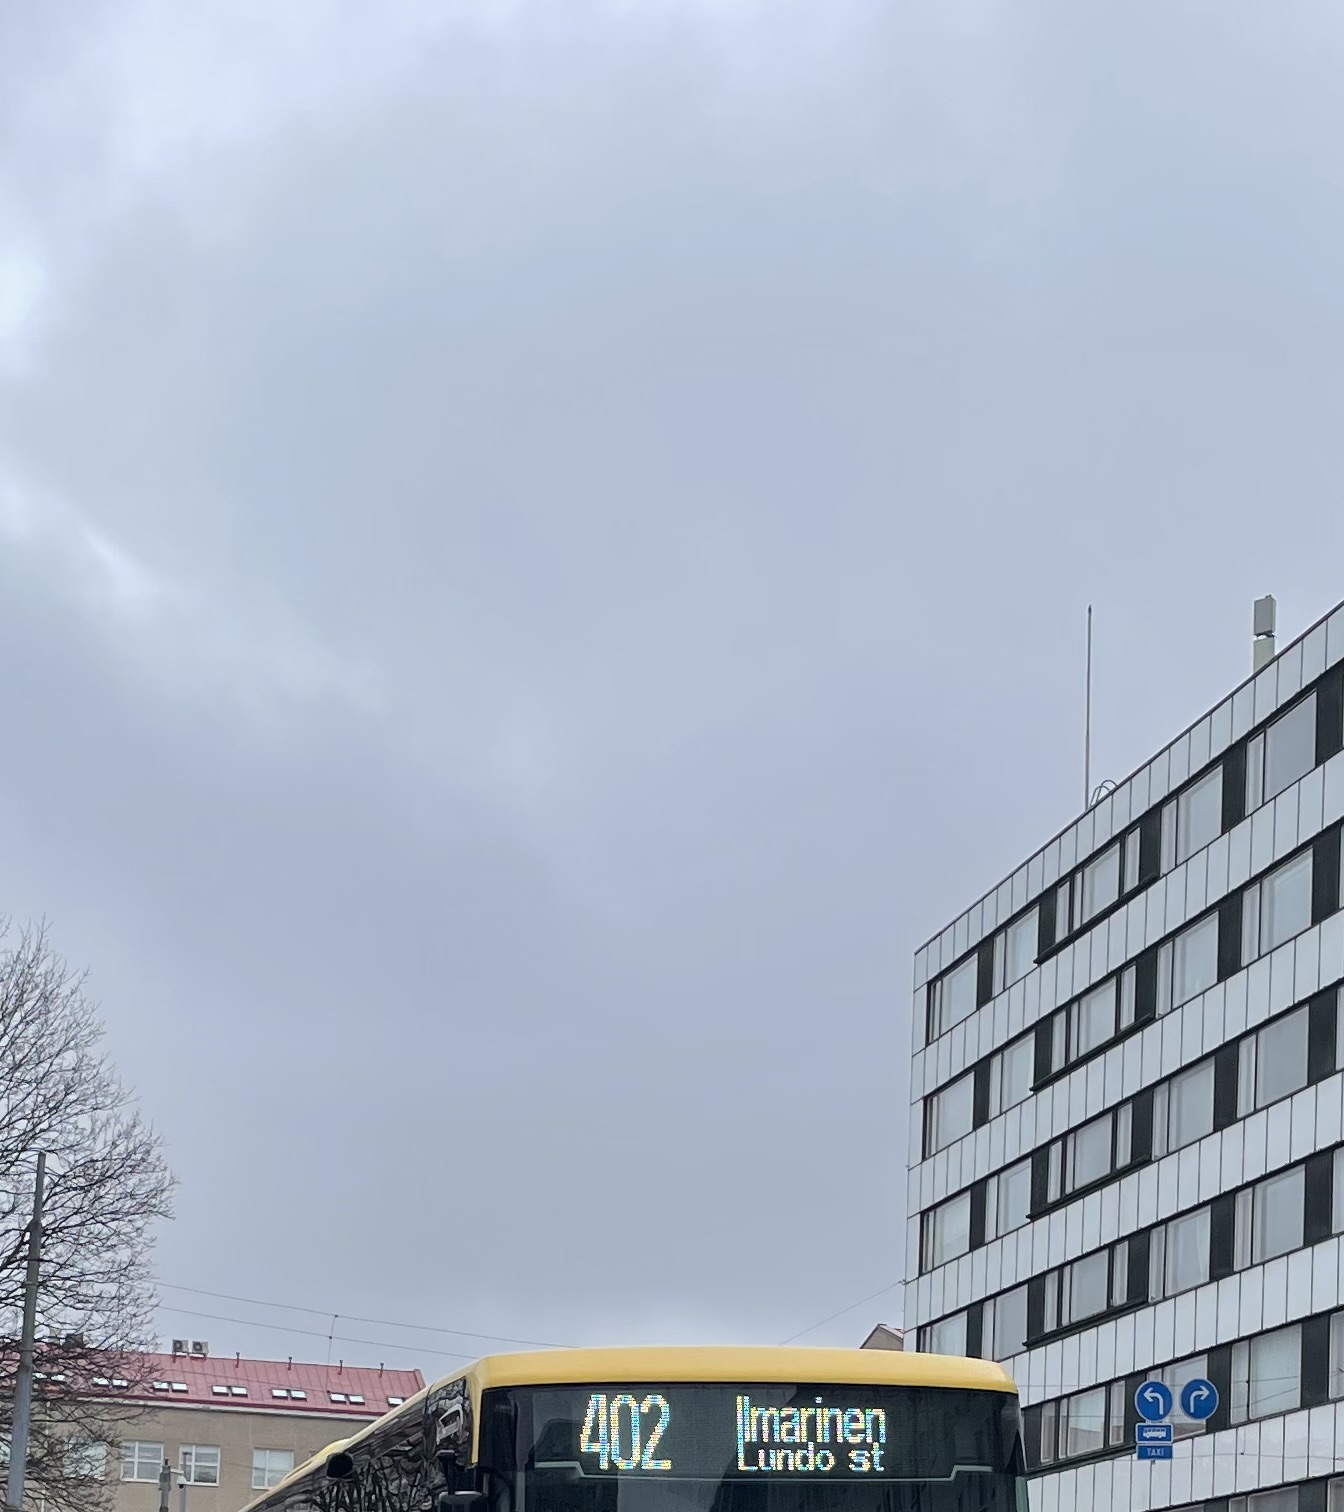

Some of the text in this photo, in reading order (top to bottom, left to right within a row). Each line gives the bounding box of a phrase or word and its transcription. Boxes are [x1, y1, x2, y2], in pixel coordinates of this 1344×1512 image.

[579, 1394, 886, 1470] 402 Ilmarinen
[737, 1441, 885, 1471] Lundo st
[1146, 1447, 1165, 1457] TAXI
